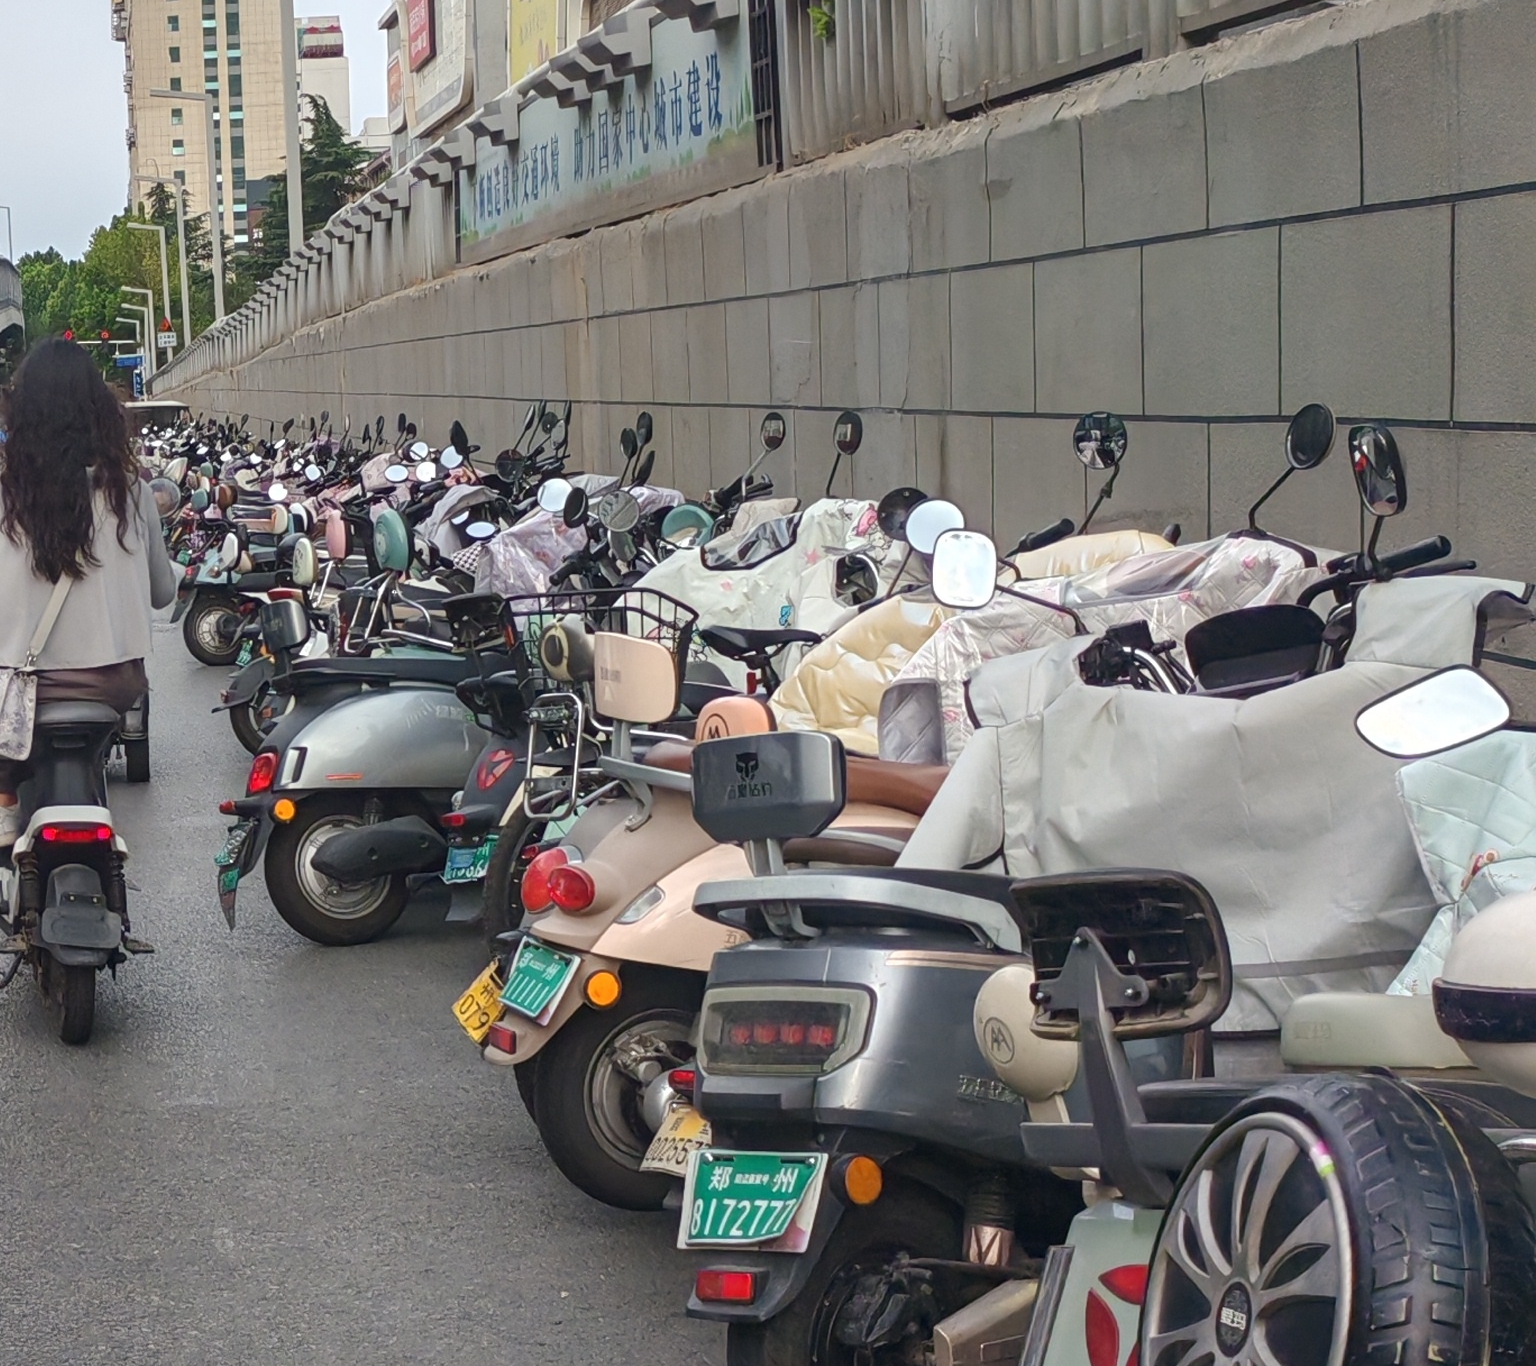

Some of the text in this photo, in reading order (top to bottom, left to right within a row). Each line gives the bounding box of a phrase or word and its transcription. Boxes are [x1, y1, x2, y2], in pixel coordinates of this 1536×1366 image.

[574, 51, 723, 184] 助力国家中心城市建设
[709, 1166, 733, 1191] 郑
[772, 1167, 799, 1193] 州
